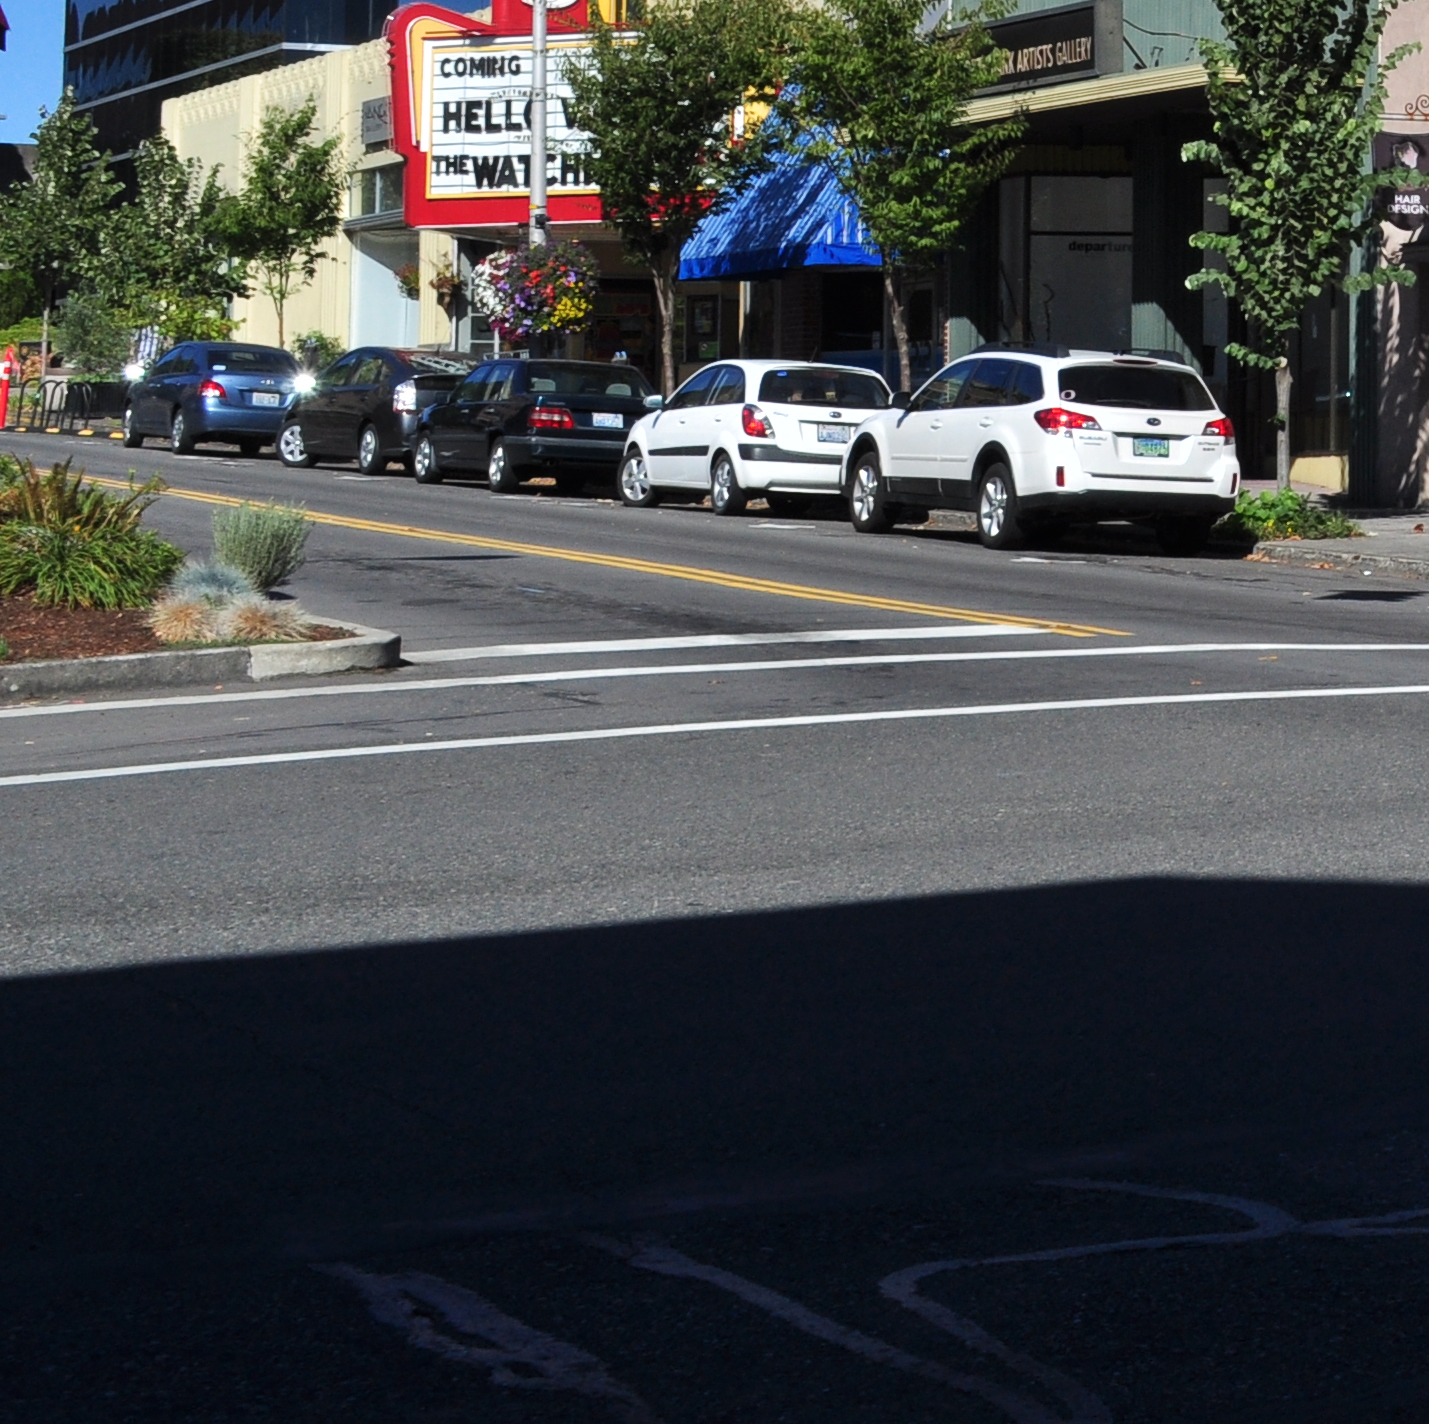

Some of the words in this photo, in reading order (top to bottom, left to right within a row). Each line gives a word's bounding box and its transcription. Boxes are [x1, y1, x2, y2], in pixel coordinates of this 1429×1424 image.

[1016, 43, 1053, 72] ARTISTS
[1055, 36, 1092, 66] GALLERY
[440, 55, 521, 79] COMING
[432, 154, 469, 177] THE
[1394, 194, 1421, 204] HAIR
